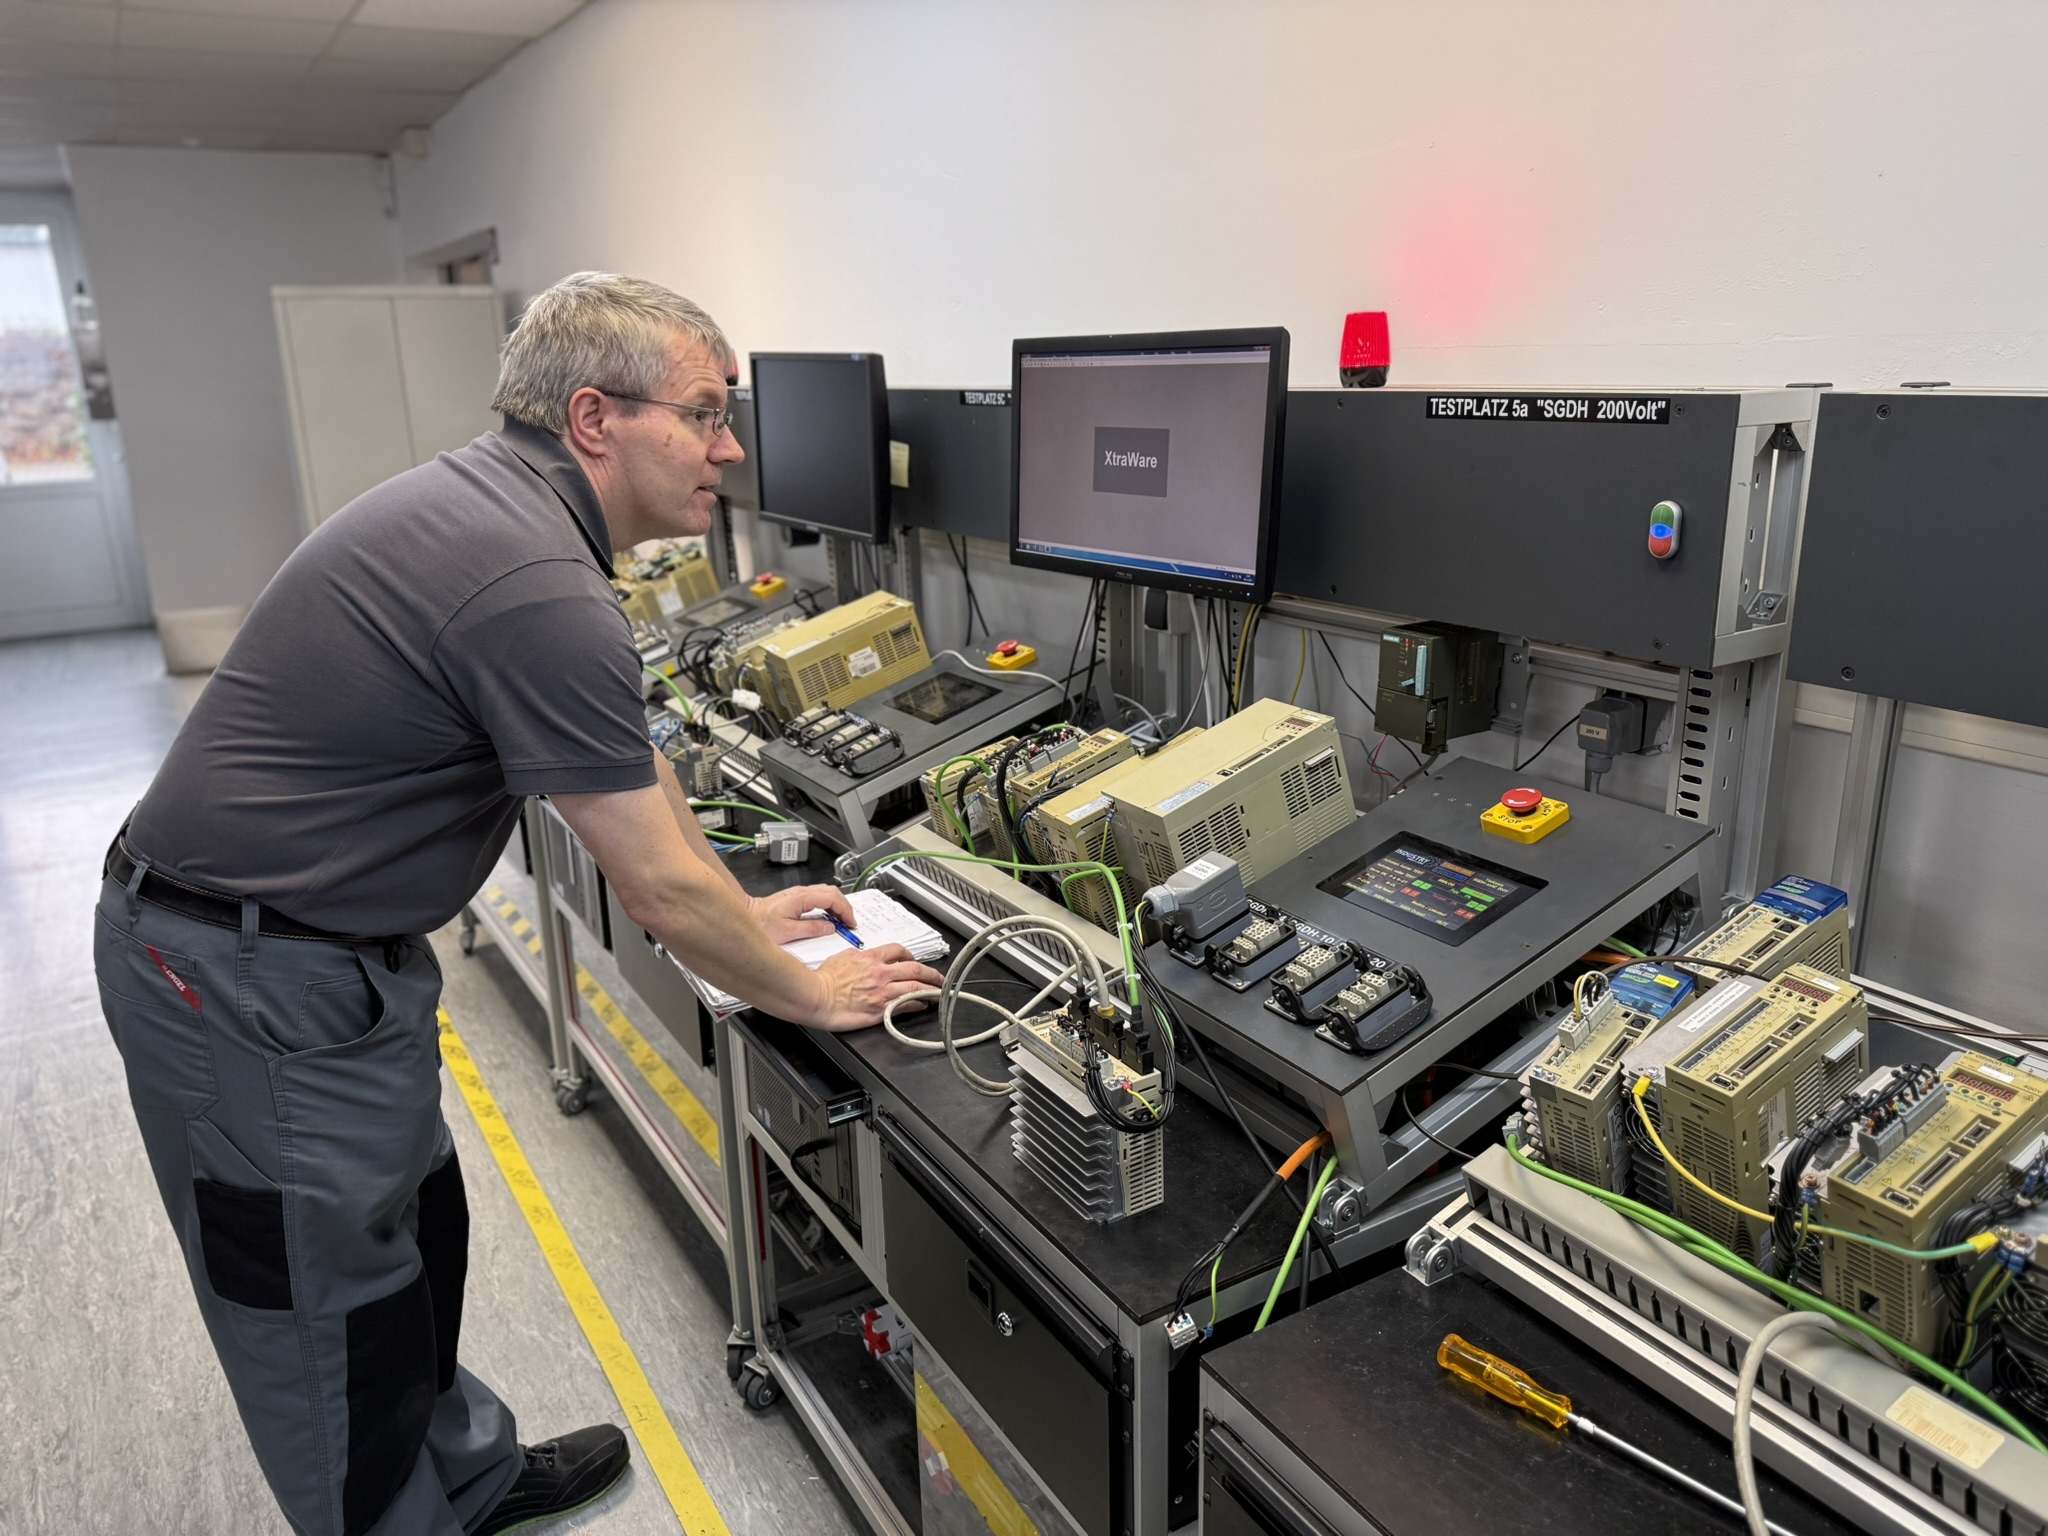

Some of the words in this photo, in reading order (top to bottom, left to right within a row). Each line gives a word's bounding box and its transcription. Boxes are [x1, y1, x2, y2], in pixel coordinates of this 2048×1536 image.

[964, 391, 997, 405] TESTPLATZ
[1430, 398, 1509, 417] TESTPLATZ
[1511, 399, 1529, 418] 5a
[1536, 399, 1588, 419] "SGDH
[1596, 400, 1666, 421] 200Volt"
[1104, 450, 1158, 469] XtraWare
[1498, 814, 1522, 825] STOP
[1394, 848, 1430, 865] INDUSTRY
